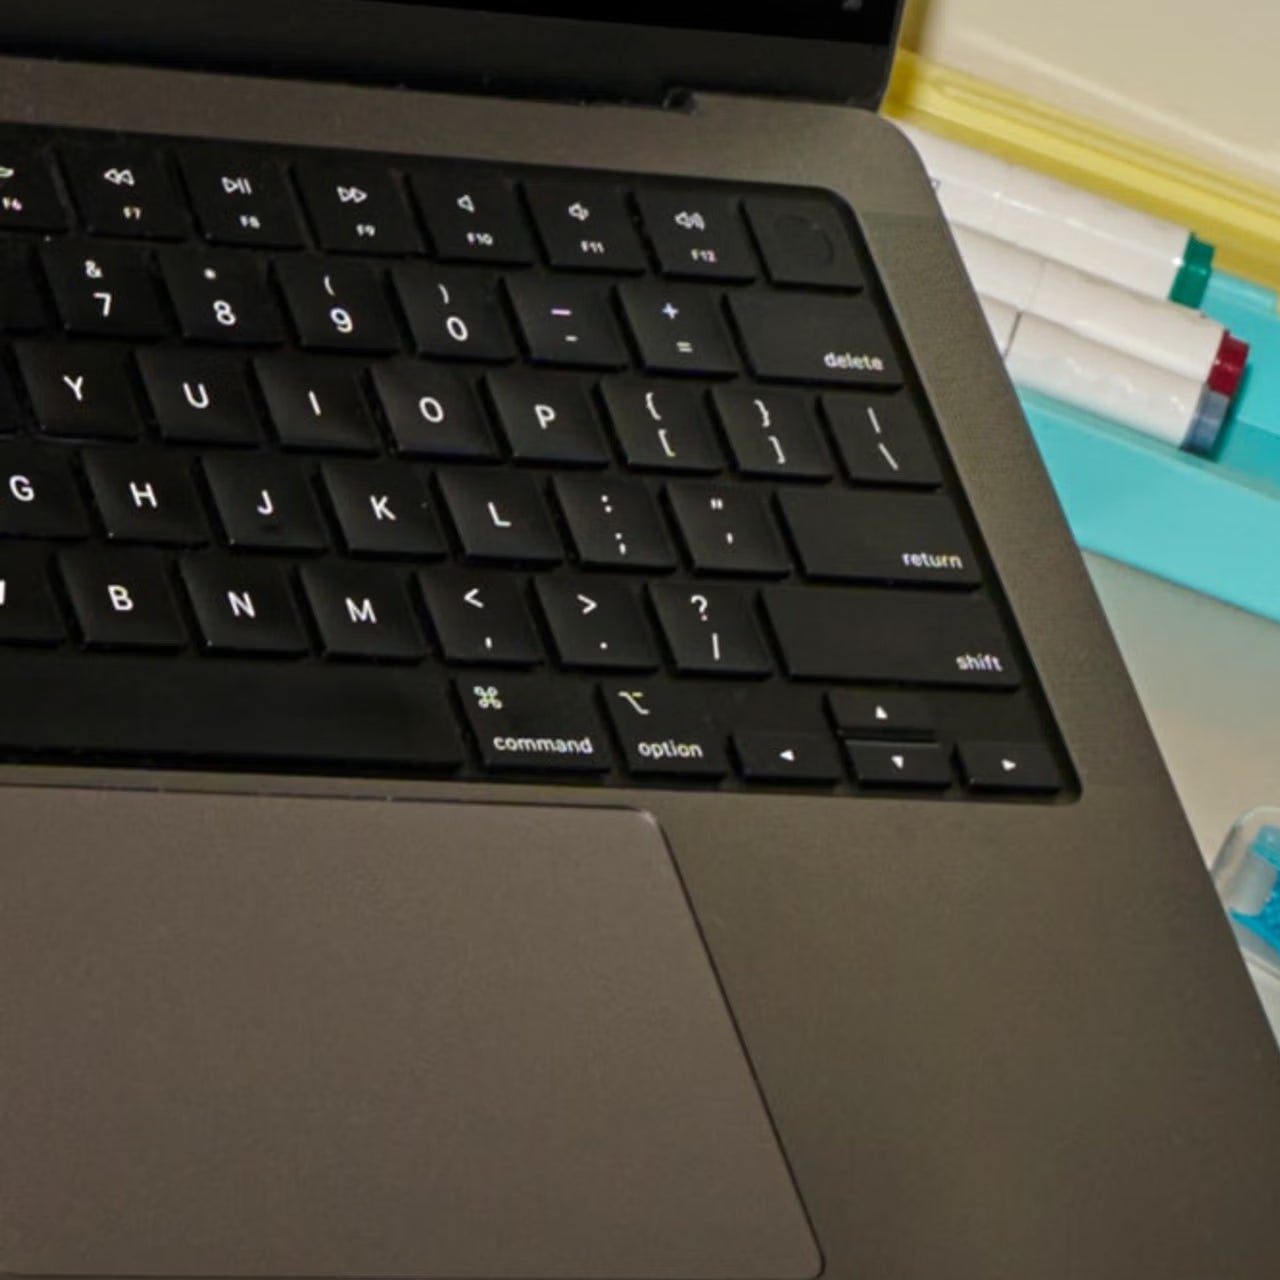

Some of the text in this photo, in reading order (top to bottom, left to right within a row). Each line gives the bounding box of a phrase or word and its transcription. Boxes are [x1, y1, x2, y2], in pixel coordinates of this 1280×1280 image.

[2, 197, 22, 211] F6
[123, 207, 141, 219] F7
[240, 215, 260, 228] F8
[356, 224, 375, 236] F9
[467, 232, 493, 245] F10
[581, 240, 604, 253] F11
[691, 249, 716, 263] F12
[93, 292, 112, 317] 7
[213, 300, 237, 326] 8
[330, 307, 353, 333] 9
[446, 316, 469, 342] 0
[823, 351, 884, 371] delete
[63, 375, 84, 401] Y
[183, 382, 209, 409] U
[308, 391, 321, 416] I
[418, 396, 444, 423] O
[534, 404, 556, 429] P
[9, 475, 35, 502] G
[129, 482, 158, 508] H
[257, 489, 274, 515] J
[370, 495, 396, 521] K
[487, 501, 512, 527] L
[901, 552, 963, 569] return
[107, 584, 134, 611] B
[227, 591, 256, 618] N
[345, 597, 377, 623] M
[956, 653, 1003, 672] shift
[493, 736, 594, 754] command
[637, 740, 703, 759] option
